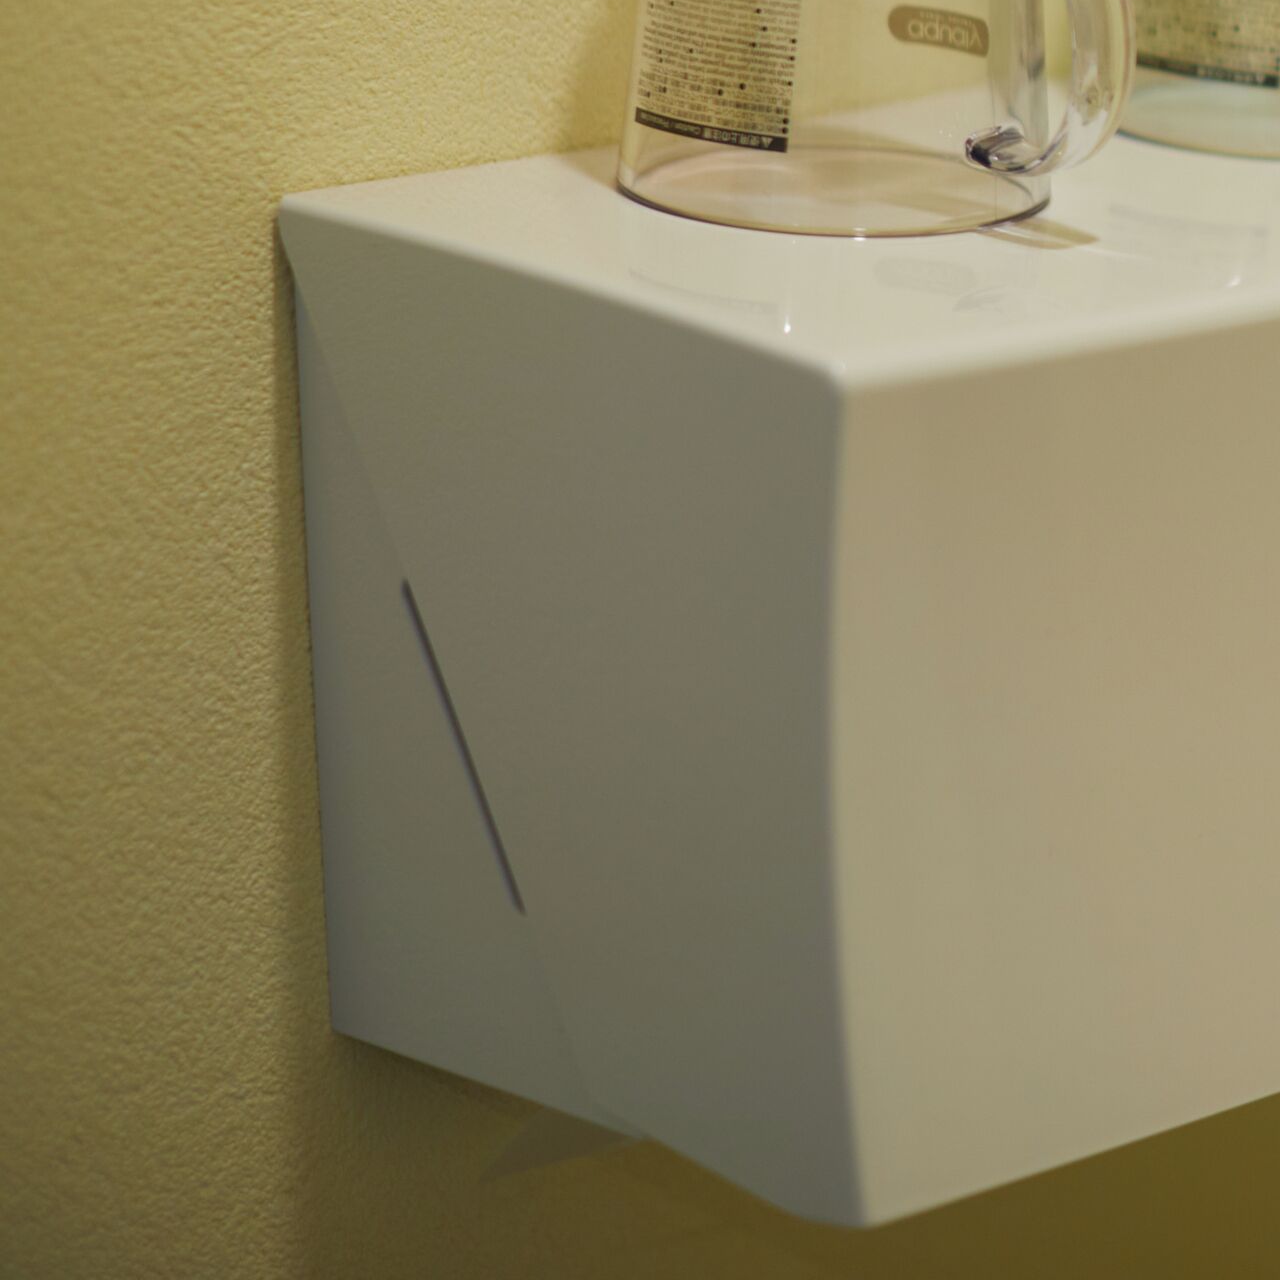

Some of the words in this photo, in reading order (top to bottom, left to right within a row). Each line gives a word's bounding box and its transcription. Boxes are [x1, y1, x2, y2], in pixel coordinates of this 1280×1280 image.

[703, 127, 760, 148] 使用上の注意
